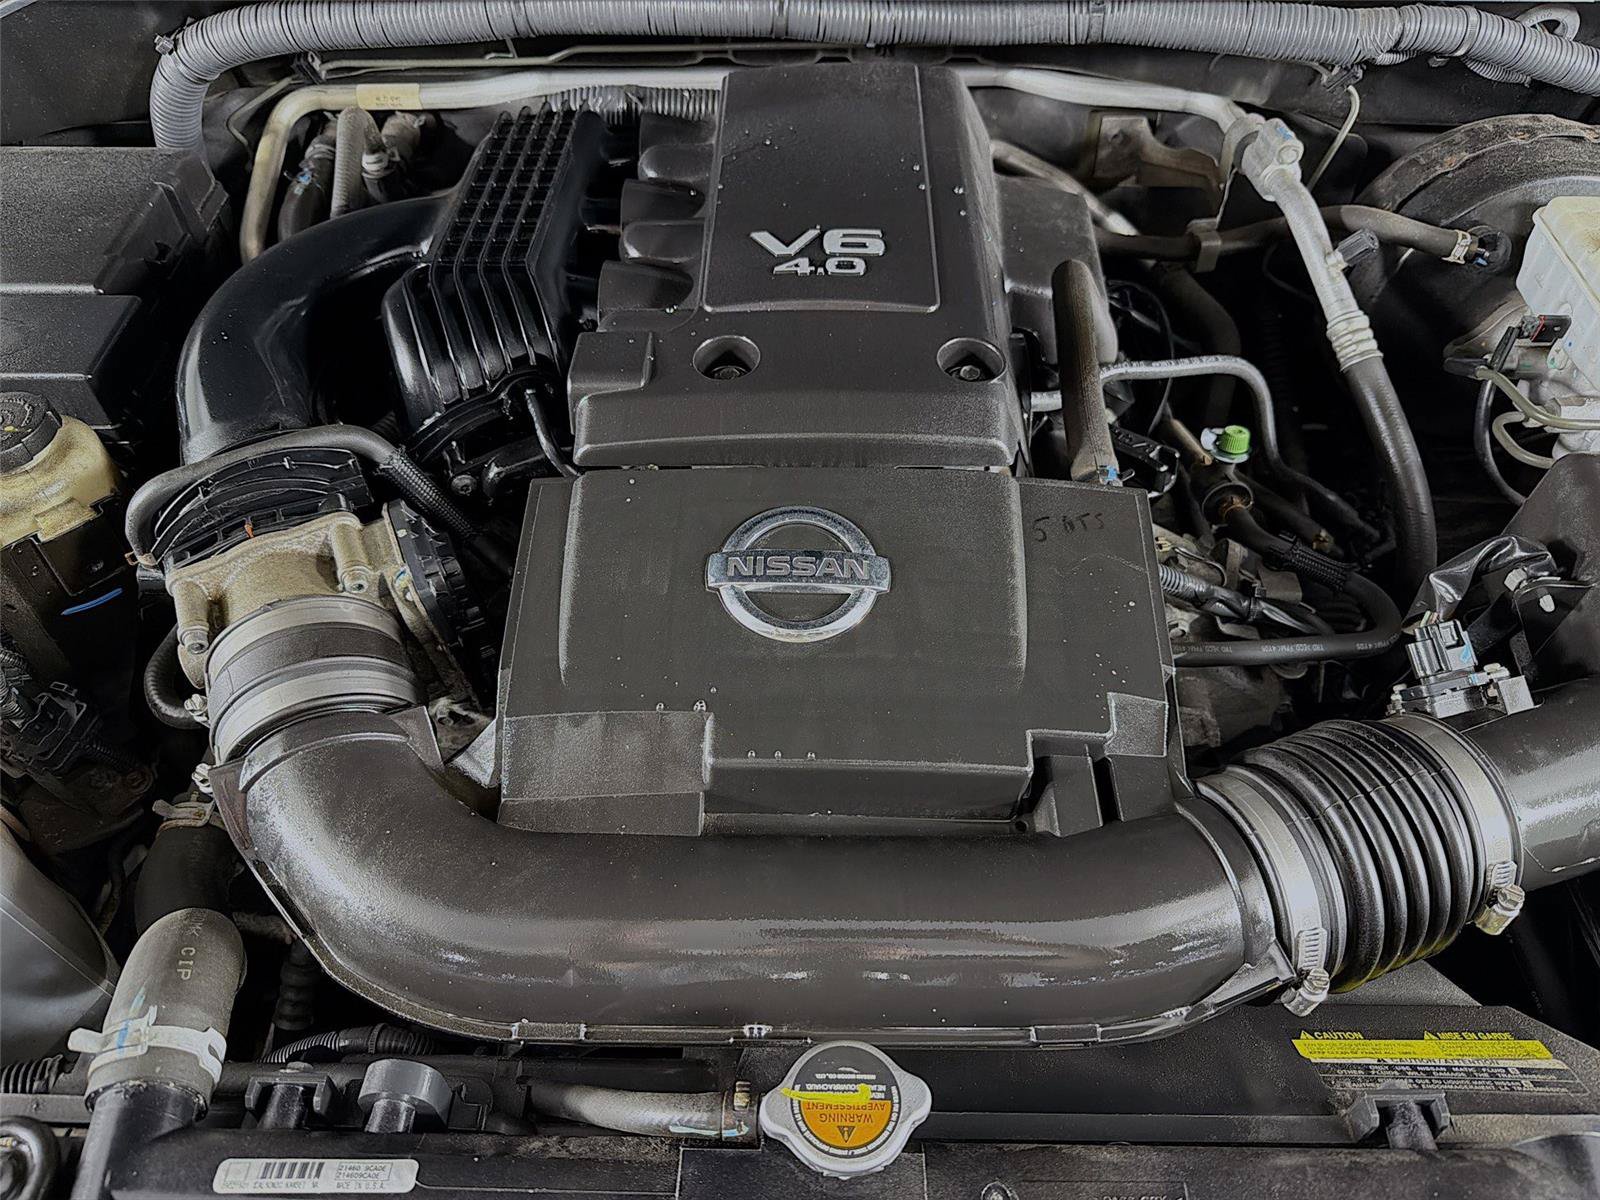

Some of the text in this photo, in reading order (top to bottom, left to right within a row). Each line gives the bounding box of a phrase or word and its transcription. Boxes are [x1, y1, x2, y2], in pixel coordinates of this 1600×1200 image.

[750, 228, 886, 257] V6
[773, 257, 866, 276] 4.0
[726, 556, 870, 580] NISSAN
[176, 947, 196, 980] CIP
[1314, 1032, 1364, 1040] CAUTION
[819, 1113, 873, 1123] WARNING
